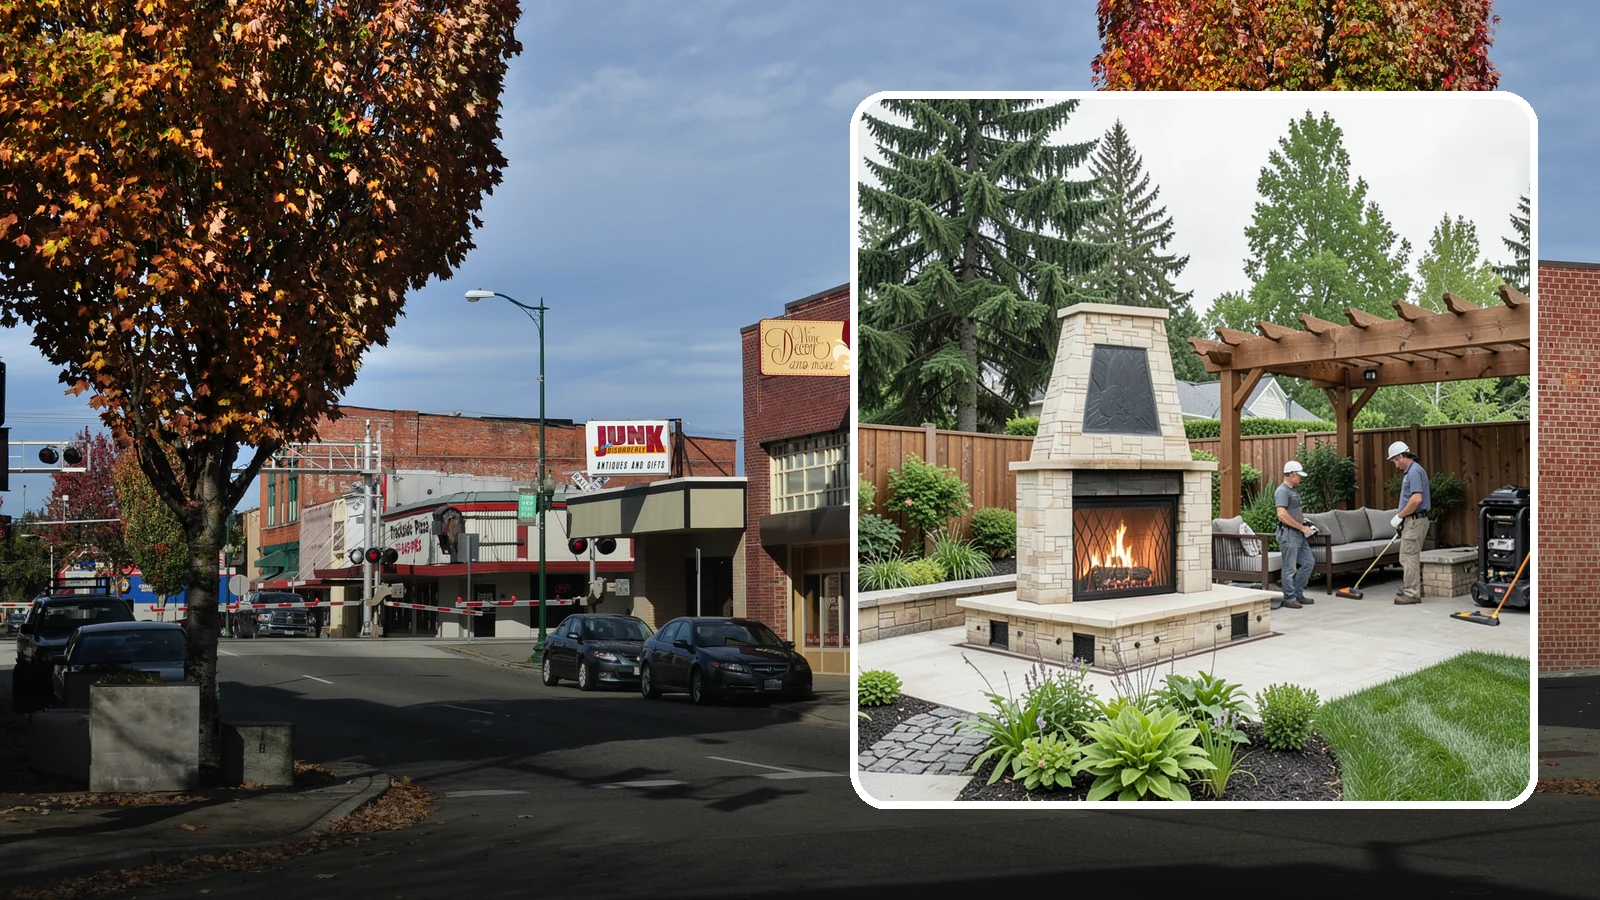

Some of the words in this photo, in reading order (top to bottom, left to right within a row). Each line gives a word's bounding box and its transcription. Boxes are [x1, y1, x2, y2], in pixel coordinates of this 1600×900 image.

[765, 327, 831, 366] Decor
[595, 425, 665, 457] JUNK
[607, 445, 646, 454] DISORDERLY
[597, 461, 628, 470] ANTIQUES
[631, 461, 644, 470] AND
[647, 460, 665, 469] GIFTS
[352, 499, 365, 511] CRO
[414, 519, 429, 535] Pizza
